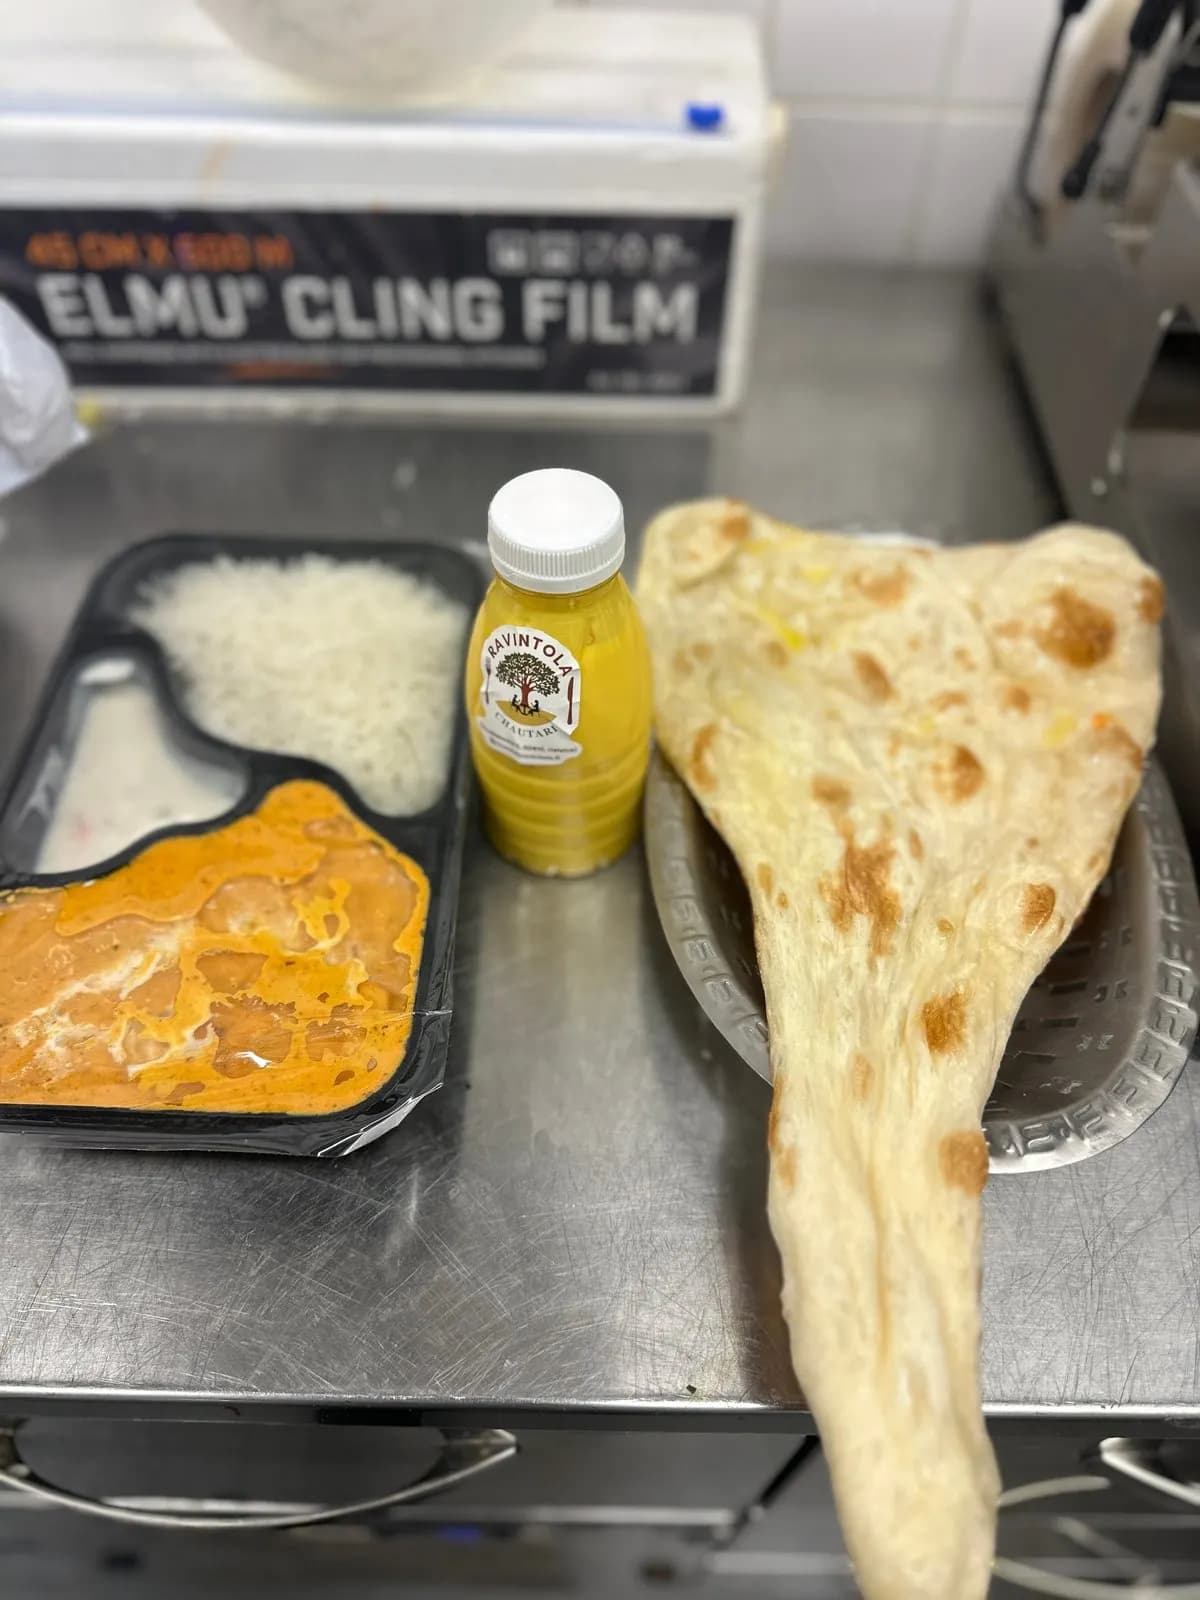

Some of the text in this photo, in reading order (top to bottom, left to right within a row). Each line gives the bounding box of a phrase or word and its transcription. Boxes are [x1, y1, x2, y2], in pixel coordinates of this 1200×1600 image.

[282, 276, 504, 343] CLING
[522, 278, 699, 345] FILM
[487, 632, 573, 677] RAVINTOLA
